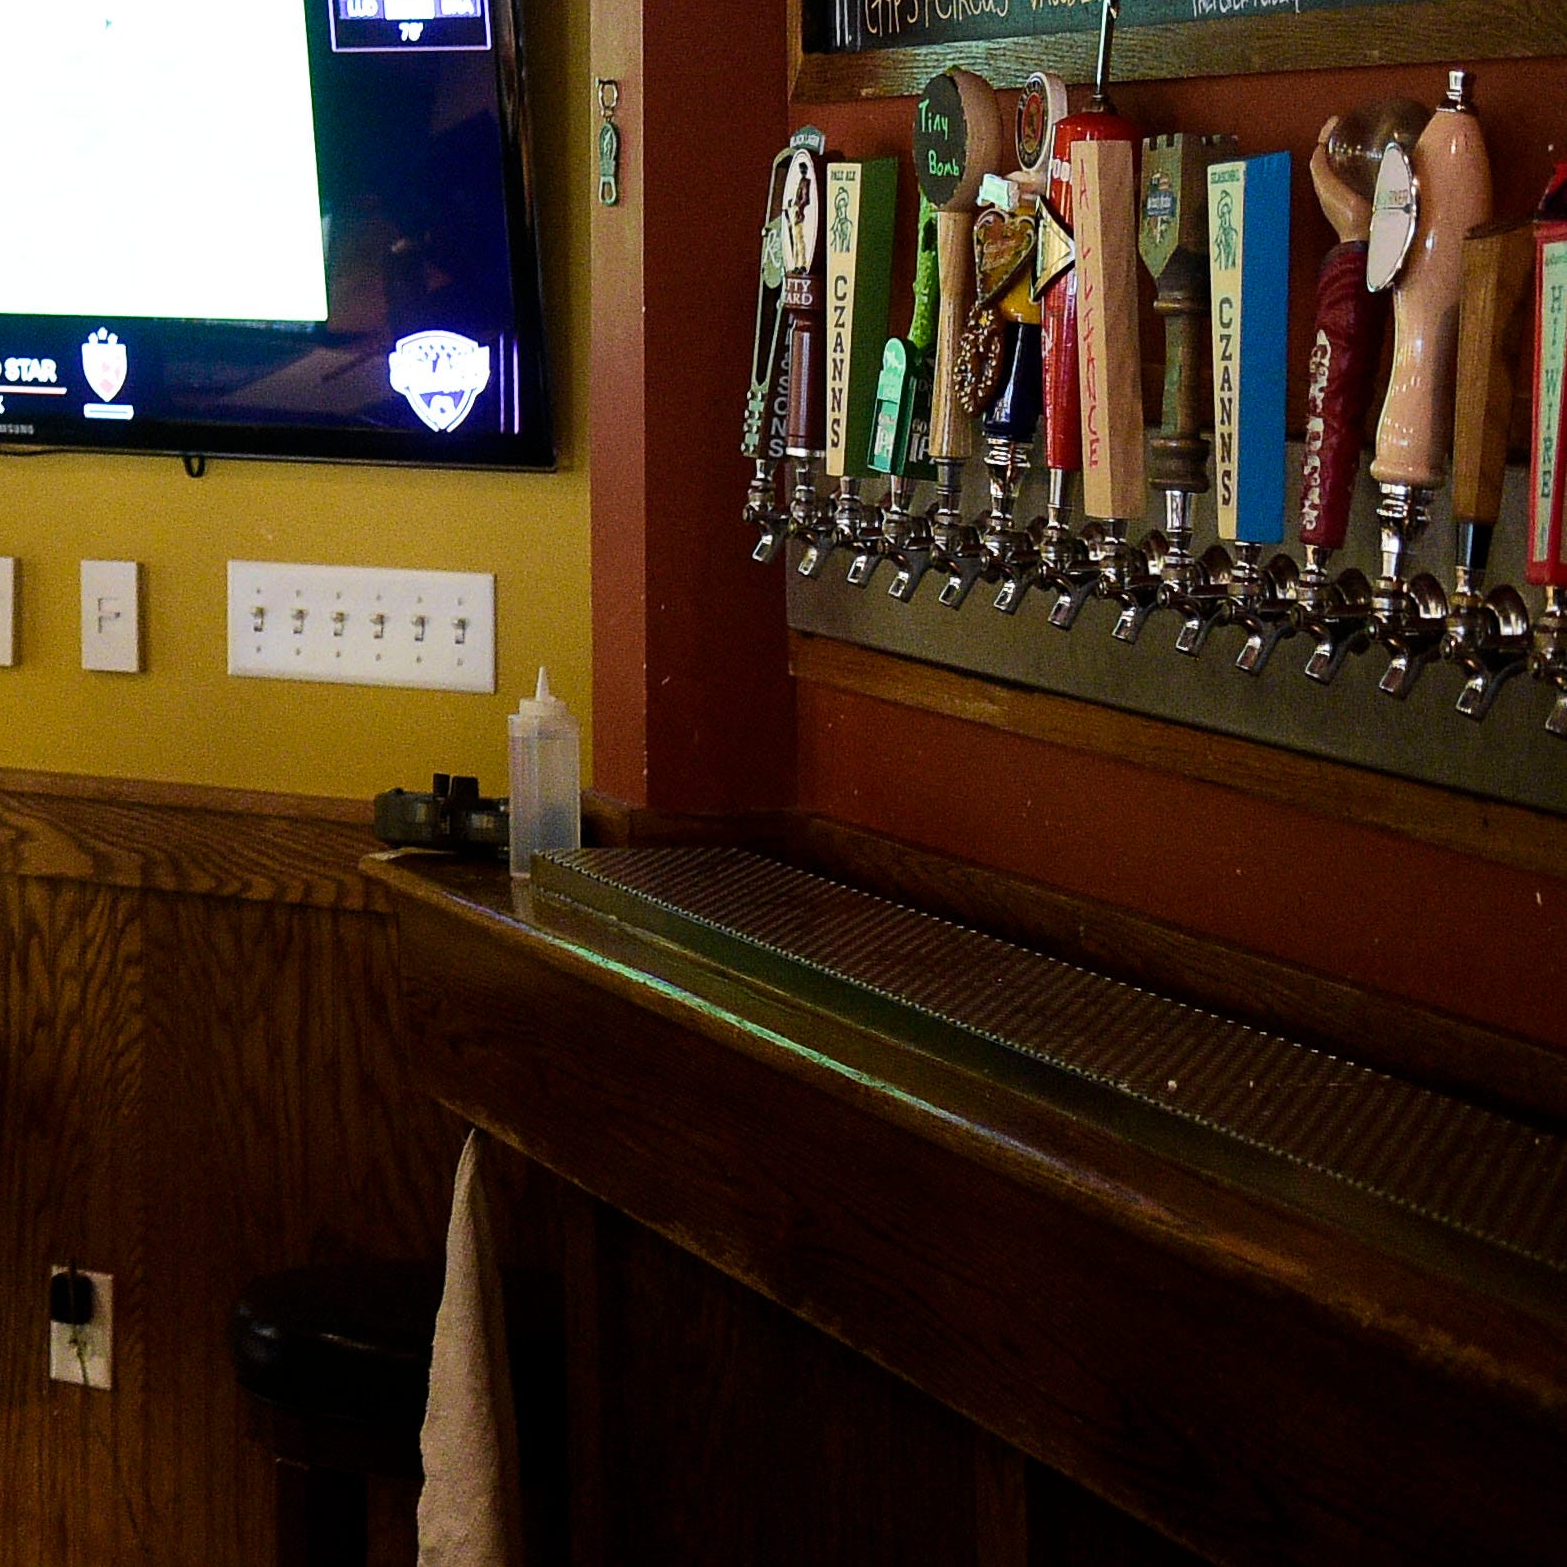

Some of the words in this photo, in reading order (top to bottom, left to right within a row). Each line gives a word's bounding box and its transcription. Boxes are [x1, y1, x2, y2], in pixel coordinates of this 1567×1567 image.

[918, 99, 949, 139] Tiny
[928, 153, 960, 178] Bomb
[4, 358, 56, 383] STAR
[831, 275, 848, 448] CZANNS
[1218, 297, 1234, 508] CZANNS
